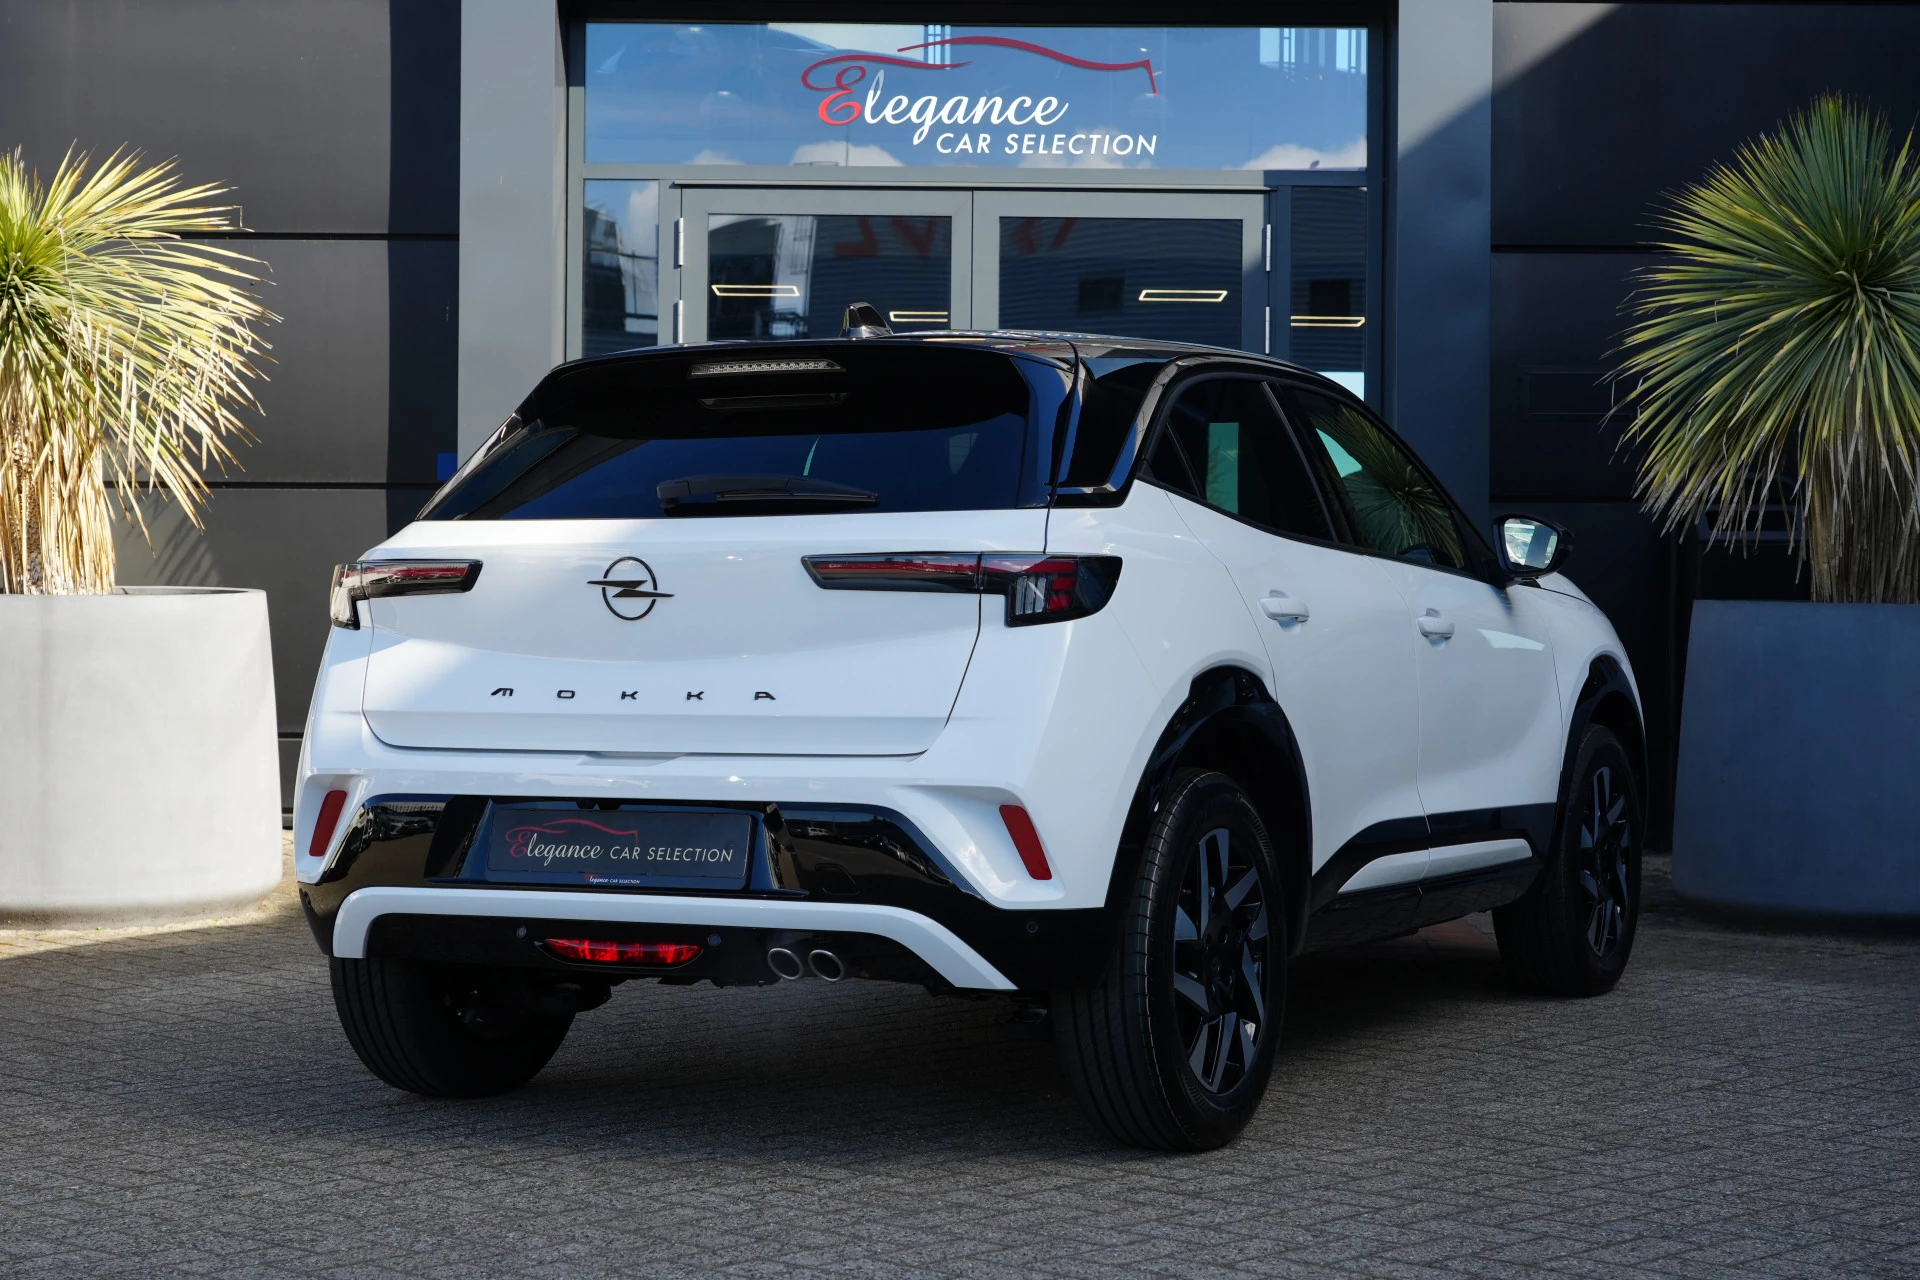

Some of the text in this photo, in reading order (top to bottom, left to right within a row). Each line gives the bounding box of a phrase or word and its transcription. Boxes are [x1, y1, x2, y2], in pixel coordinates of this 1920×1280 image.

[803, 64, 1068, 145] Elegance
[936, 132, 1157, 155] CAR SELECTION
[490, 687, 777, 701] MOKKA
[507, 831, 733, 866] Elegance CAR SELECTION
